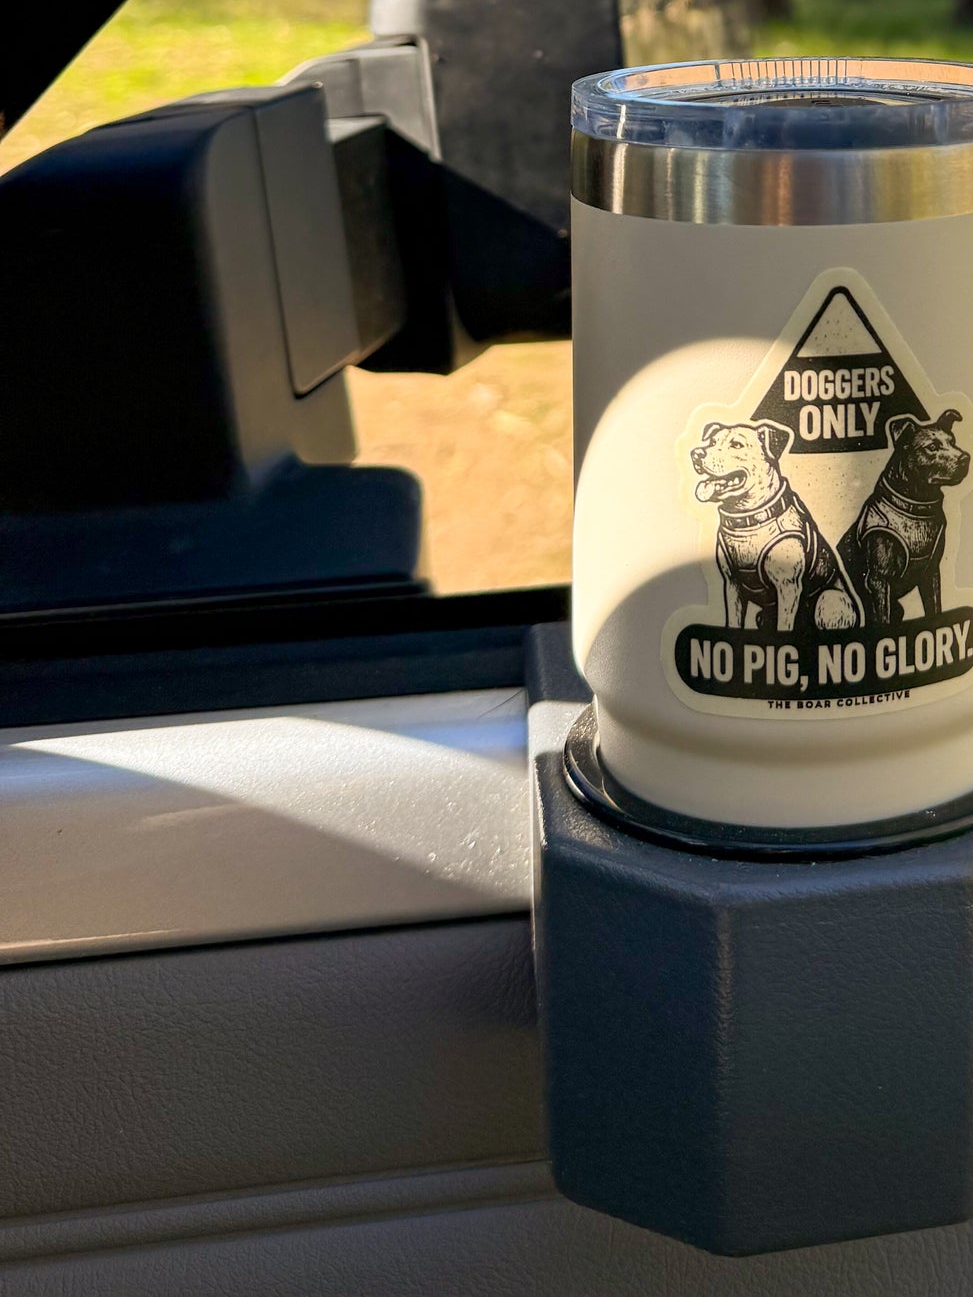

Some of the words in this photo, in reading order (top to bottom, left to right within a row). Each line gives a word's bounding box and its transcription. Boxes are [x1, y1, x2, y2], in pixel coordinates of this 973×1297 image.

[784, 365, 896, 401] DOGGERS
[799, 402, 881, 441] ONLY
[690, 638, 734, 683] NO
[743, 644, 809, 692] PIG,
[818, 641, 866, 684] NO
[875, 619, 973, 679] GLORY.
[767, 700, 791, 709] THE
[797, 699, 831, 709] BOAR
[836, 690, 911, 707] COLLECTIVE
